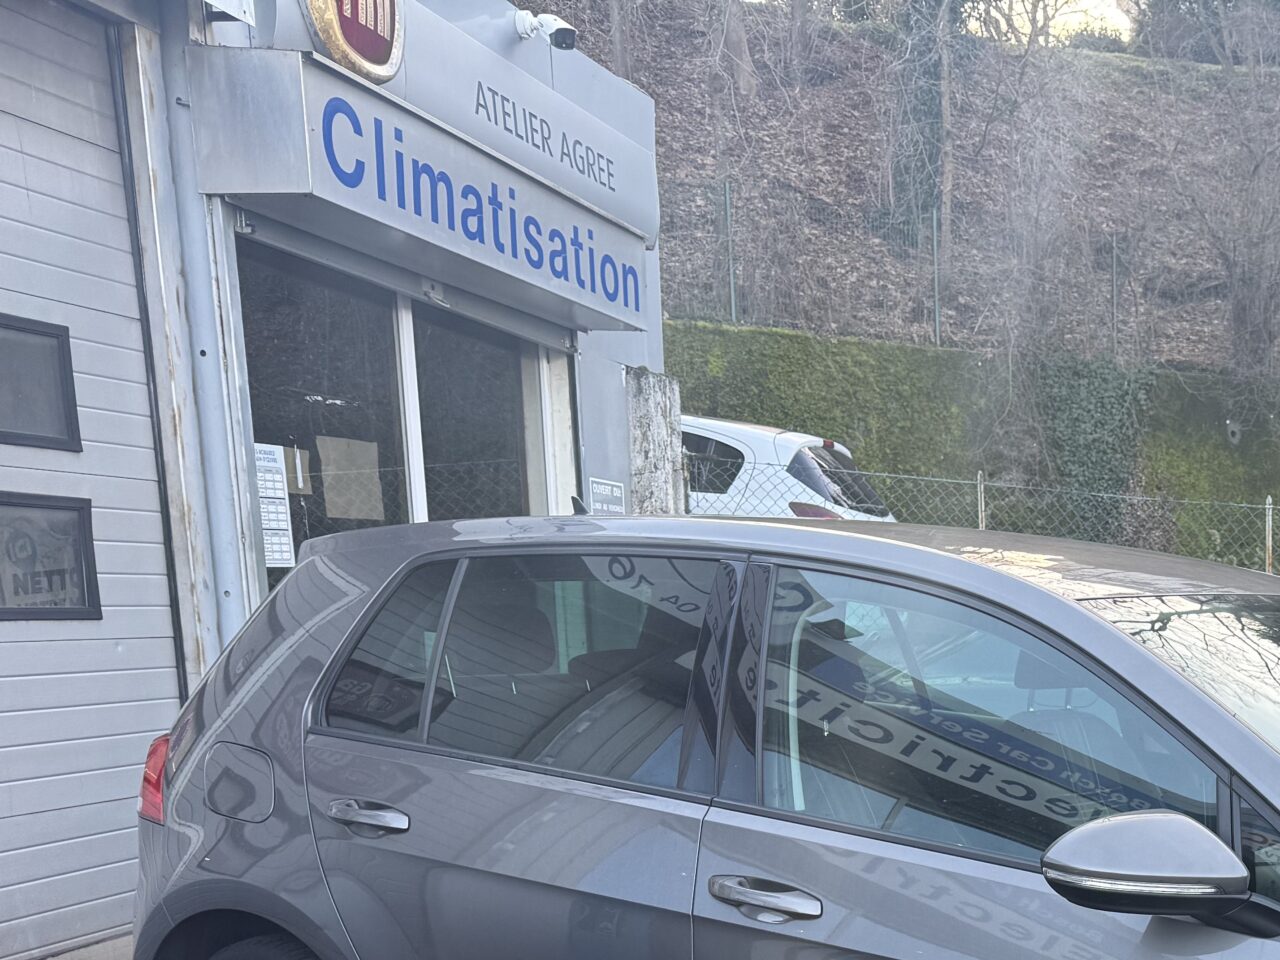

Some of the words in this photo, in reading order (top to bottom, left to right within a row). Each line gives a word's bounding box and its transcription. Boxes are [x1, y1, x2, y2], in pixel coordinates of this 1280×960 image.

[322, 96, 640, 313] Climatisation
[474, 80, 553, 157] ATELIER
[560, 132, 616, 192] AGREE
